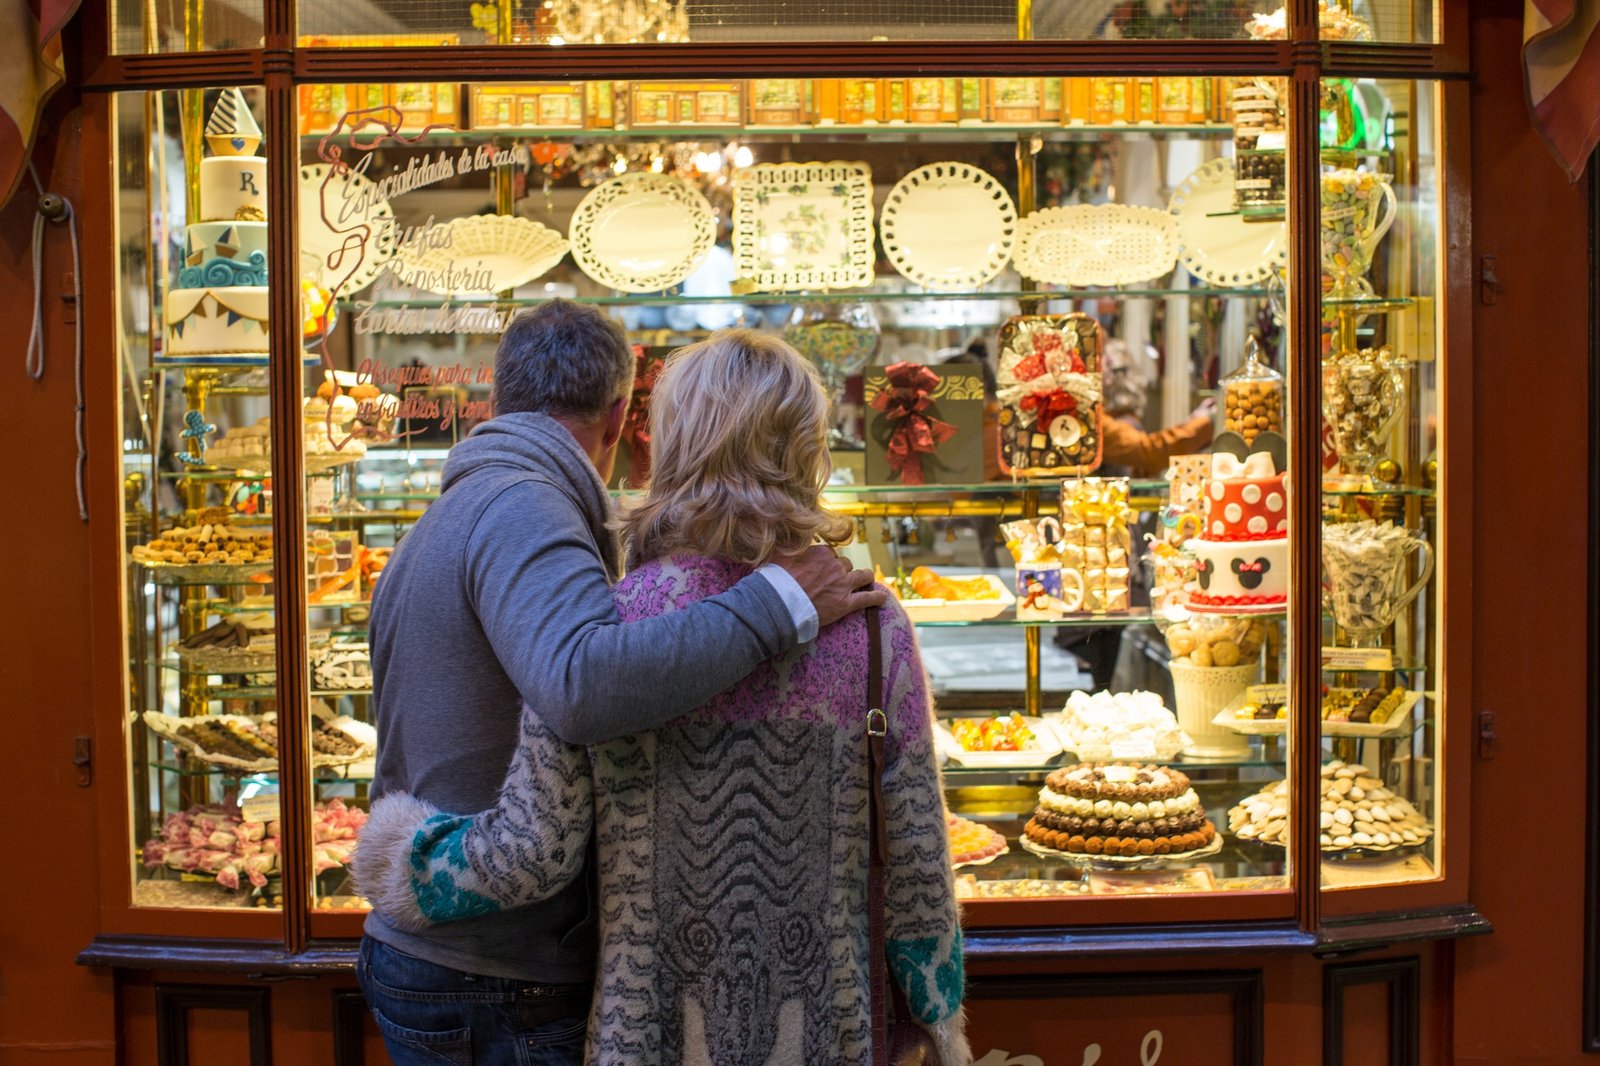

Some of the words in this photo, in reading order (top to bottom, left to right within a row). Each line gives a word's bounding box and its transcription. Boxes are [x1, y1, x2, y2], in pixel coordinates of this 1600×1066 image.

[239, 171, 260, 196] R
[338, 151, 455, 224] Especialidades
[457, 147, 473, 175] de
[474, 144, 491, 171] la
[491, 147, 527, 168] casa
[371, 214, 454, 259] Trufas
[353, 299, 428, 335] Tartas
[356, 358, 433, 393] Obsequios
[433, 363, 474, 392] para
[441, 399, 457, 431] y
